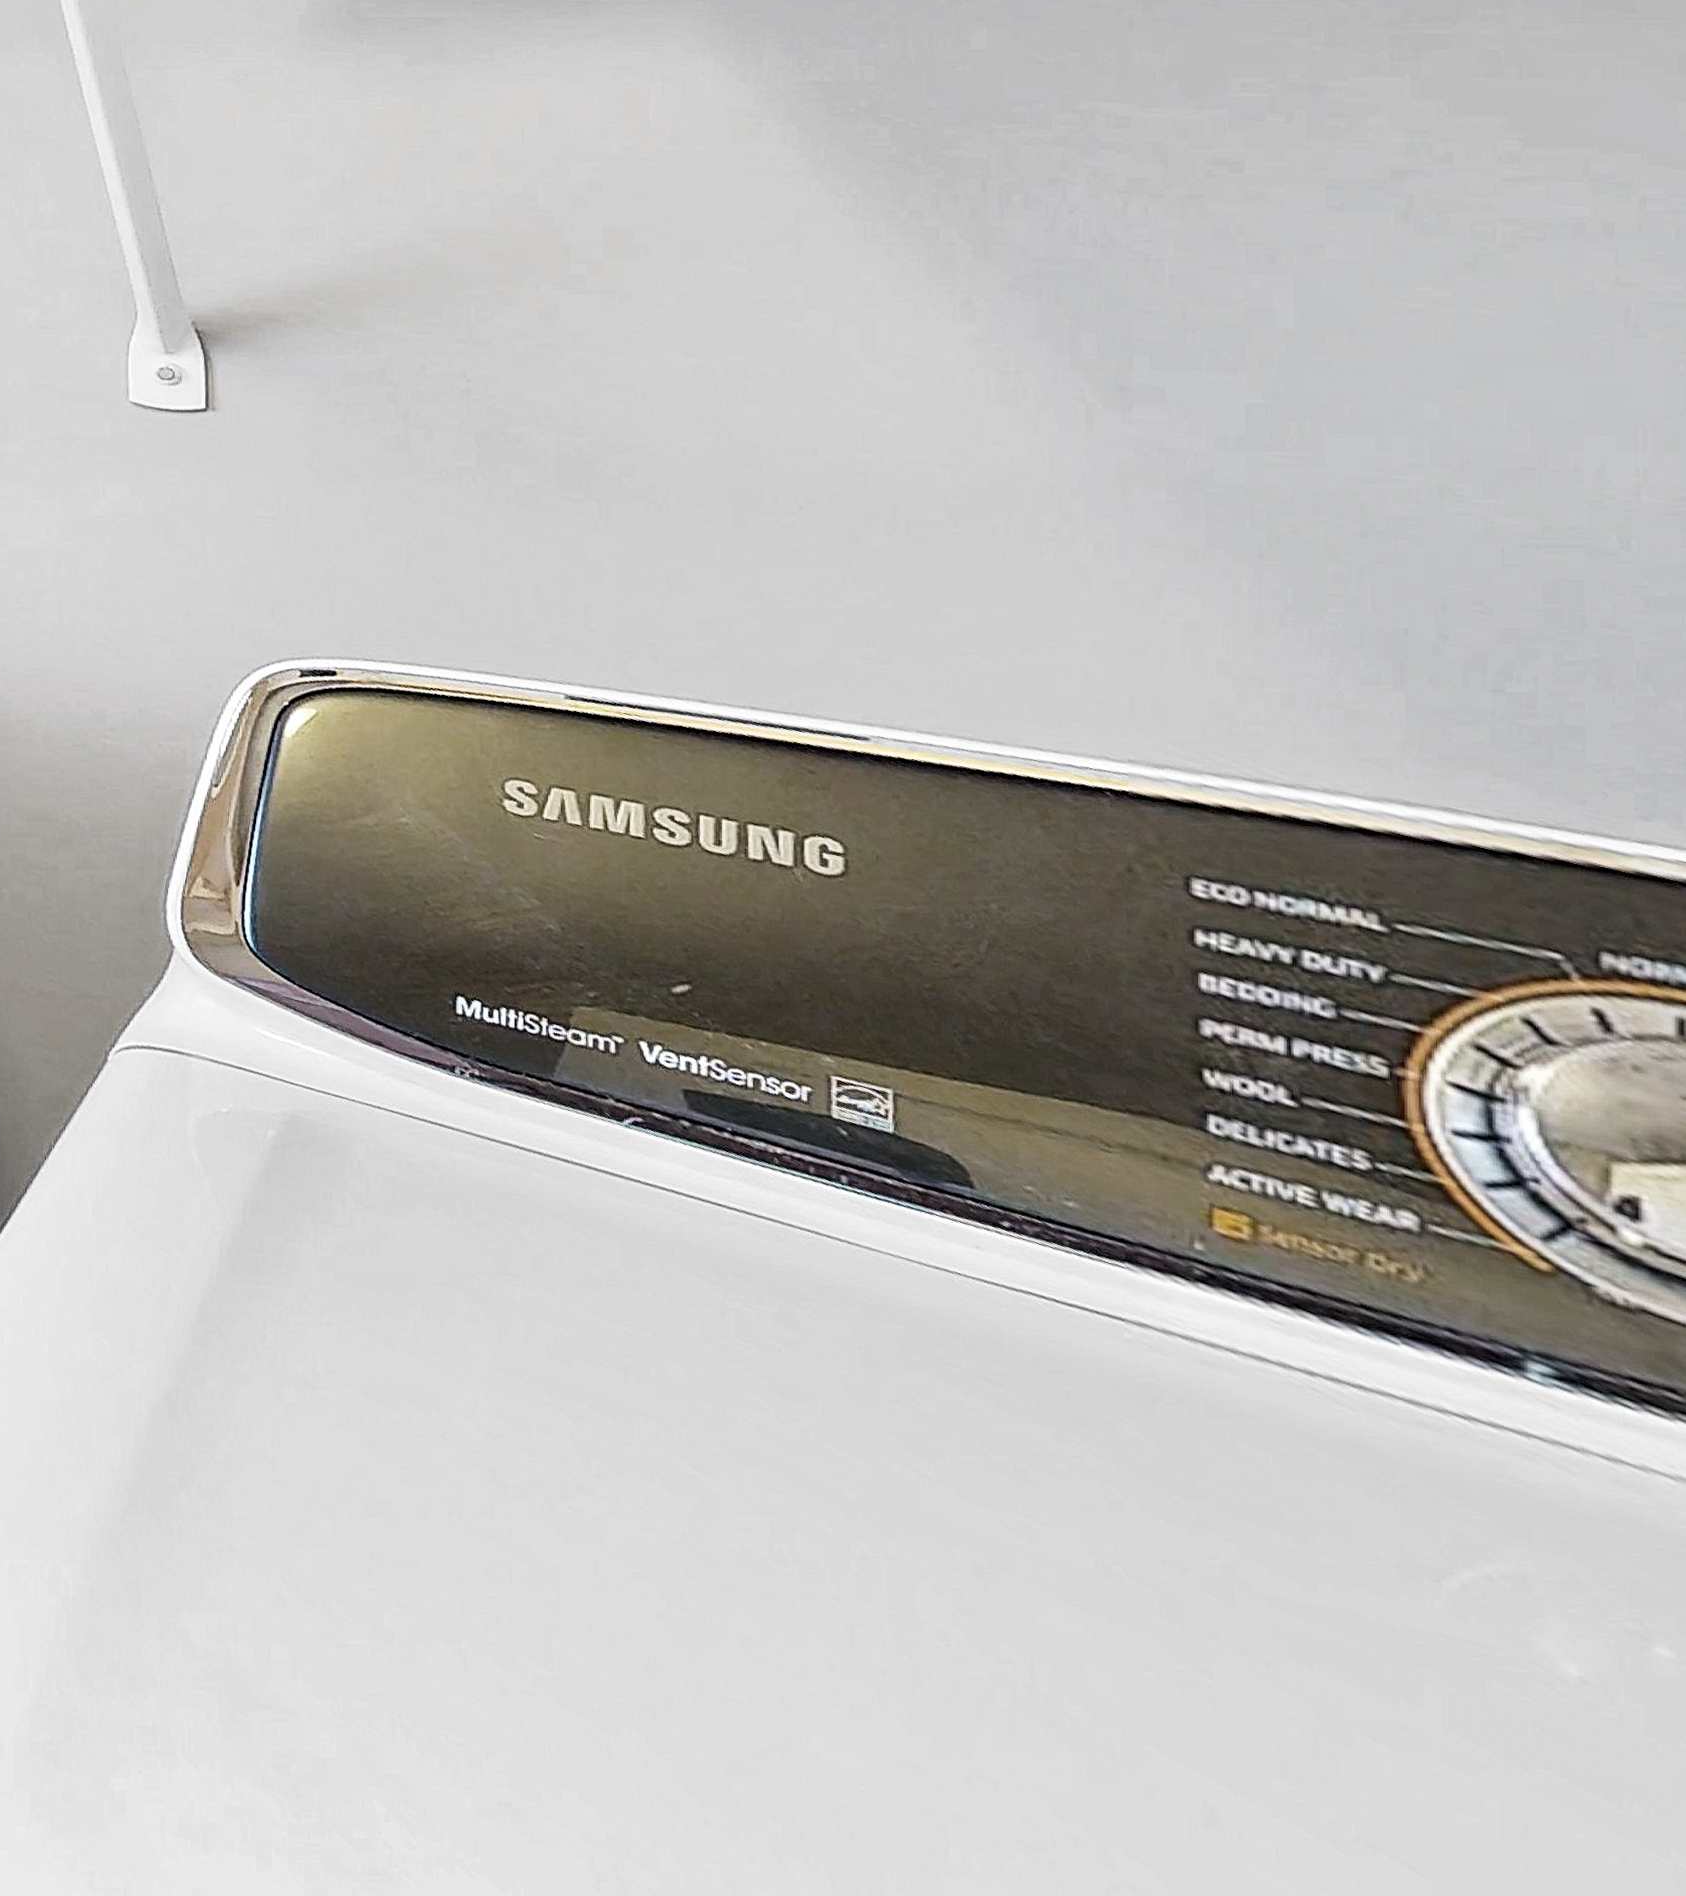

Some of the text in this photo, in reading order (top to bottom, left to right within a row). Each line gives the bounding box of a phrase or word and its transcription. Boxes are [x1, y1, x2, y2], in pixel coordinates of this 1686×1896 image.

[502, 778, 846, 877] SAMSUNG
[1189, 877, 1390, 934] ECO NORMAL
[1194, 928, 1389, 984] HEAVY DUTY
[1197, 972, 1338, 1019] BEDDING
[638, 1040, 814, 1103] VentSensor
[1198, 1018, 1392, 1080] PERM PRESS
[1201, 1067, 1299, 1108] WOOL
[1206, 1112, 1374, 1172] DELICATES
[1206, 1163, 1423, 1233] ACTIVE WEAR
